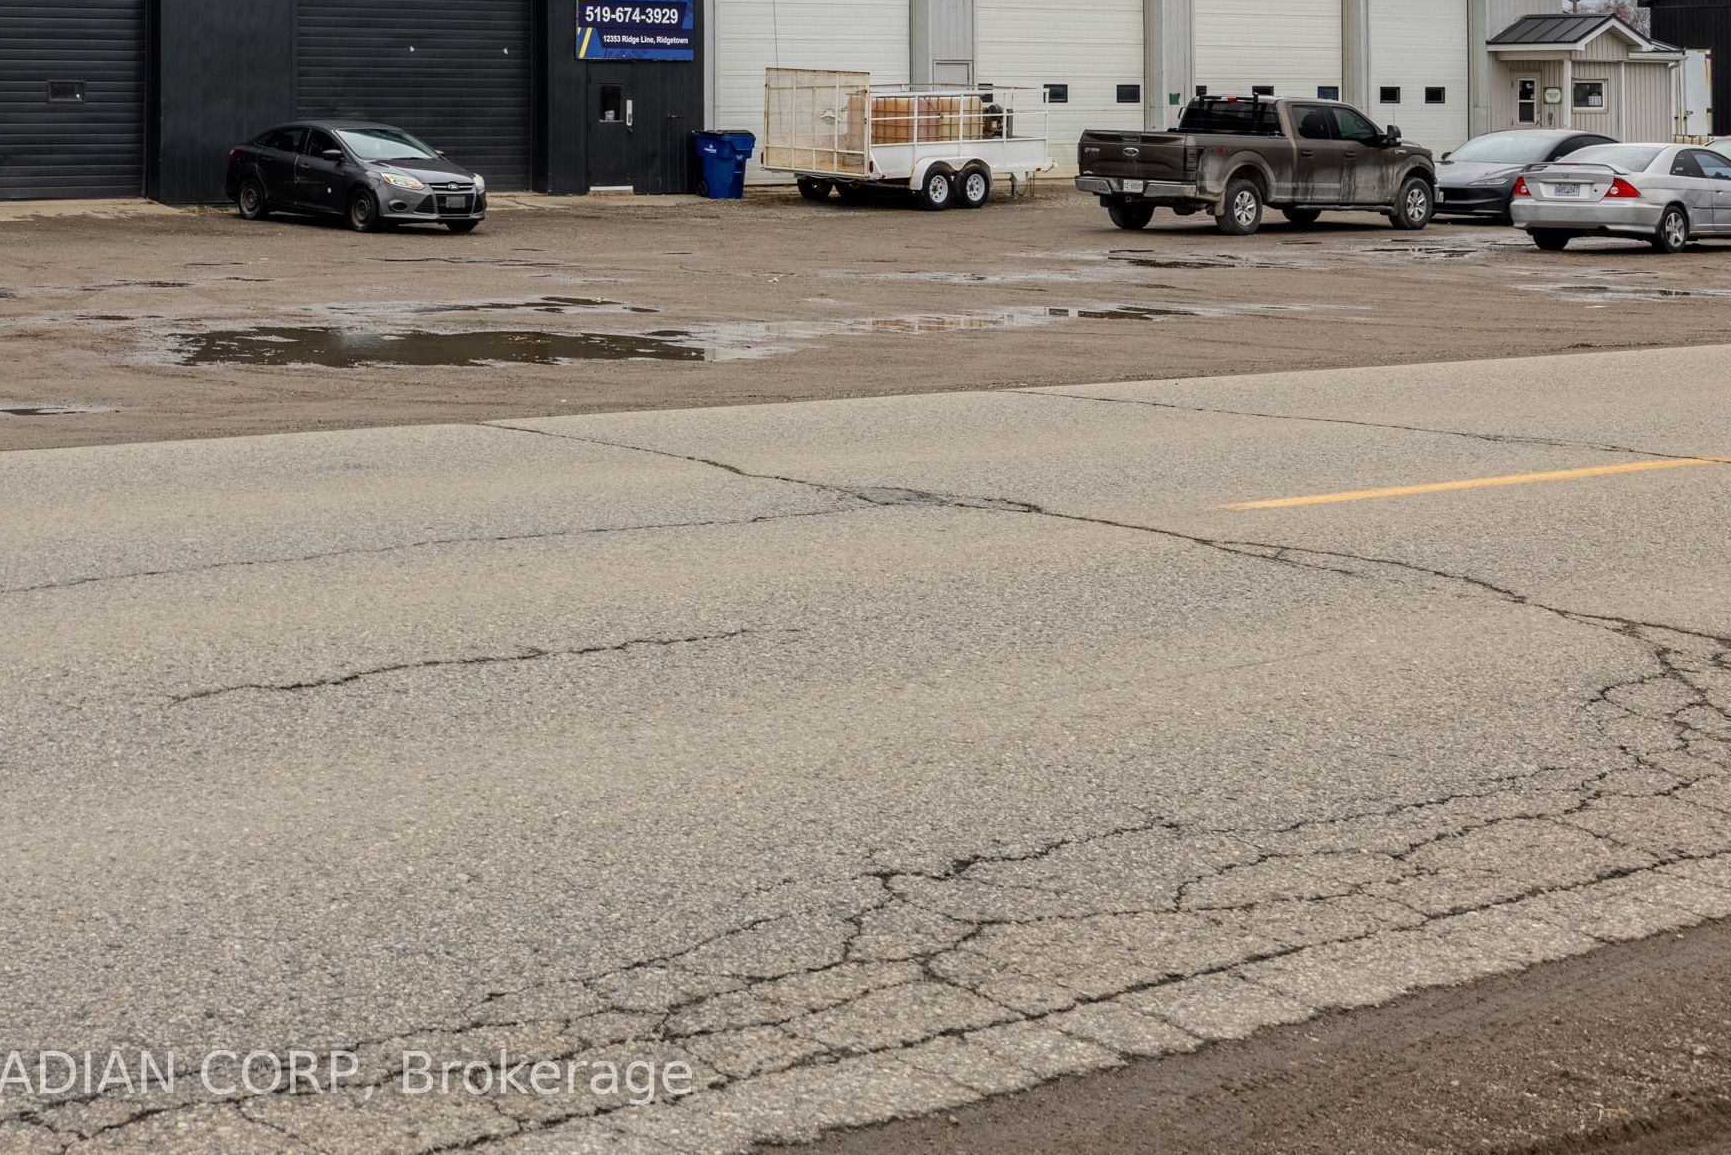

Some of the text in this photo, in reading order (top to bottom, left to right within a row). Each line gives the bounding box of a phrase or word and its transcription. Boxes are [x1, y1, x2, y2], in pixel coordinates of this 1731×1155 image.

[585, 6, 679, 24] 519-674-3929
[603, 35, 621, 43] 12353
[622, 35, 640, 45] Ridge
[656, 36, 689, 45] Ridgetown
